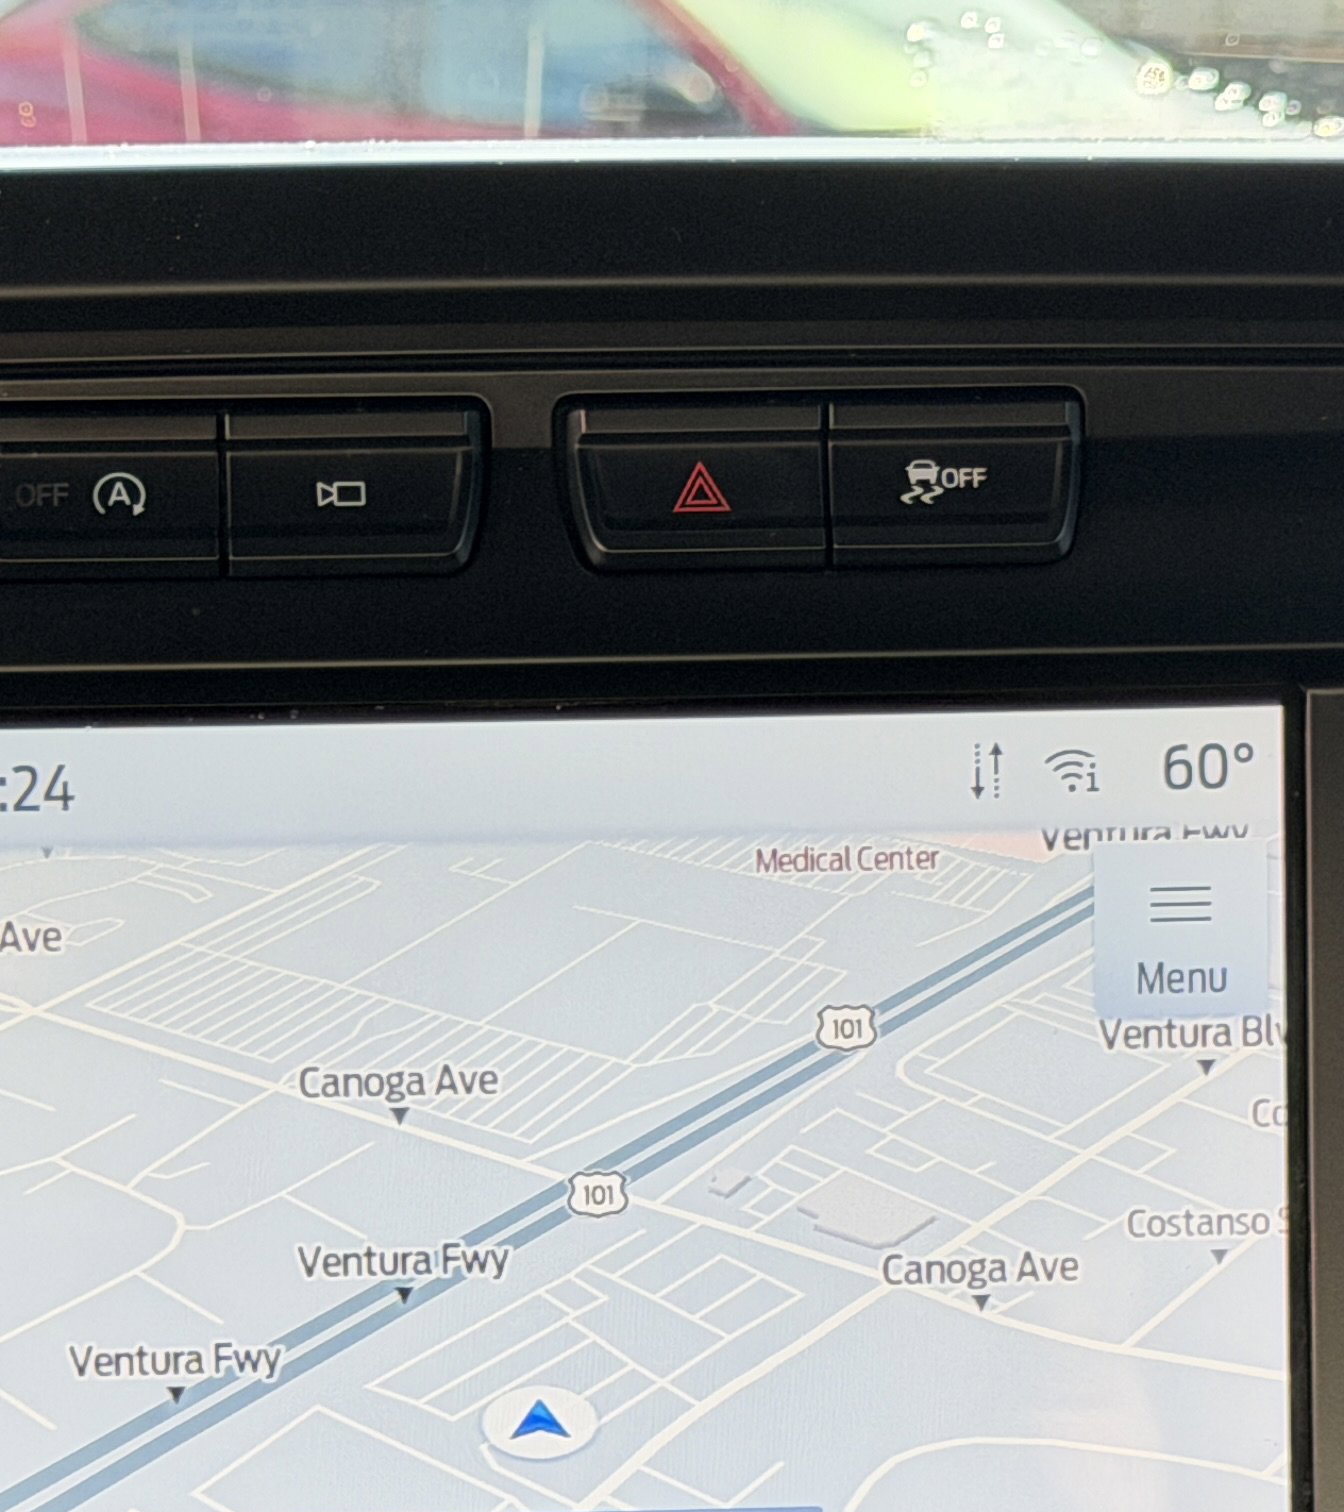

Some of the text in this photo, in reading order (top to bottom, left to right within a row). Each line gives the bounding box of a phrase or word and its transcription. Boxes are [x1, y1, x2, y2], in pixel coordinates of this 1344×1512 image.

[941, 467, 988, 488] OFF
[1164, 742, 1254, 790] 60°
[755, 845, 939, 873] Medical Center
[1136, 962, 1227, 994] Menu
[832, 1018, 862, 1040] 101
[1099, 1017, 1232, 1050] Ventura
[299, 1064, 499, 1100] Canoga Ave
[583, 1184, 614, 1208] 101
[1128, 1208, 1270, 1238] Costanso
[298, 1243, 510, 1279] Ventura Fwy
[882, 1250, 1079, 1288] Canoga Ave
[69, 1343, 282, 1379] Ventura Fwy
